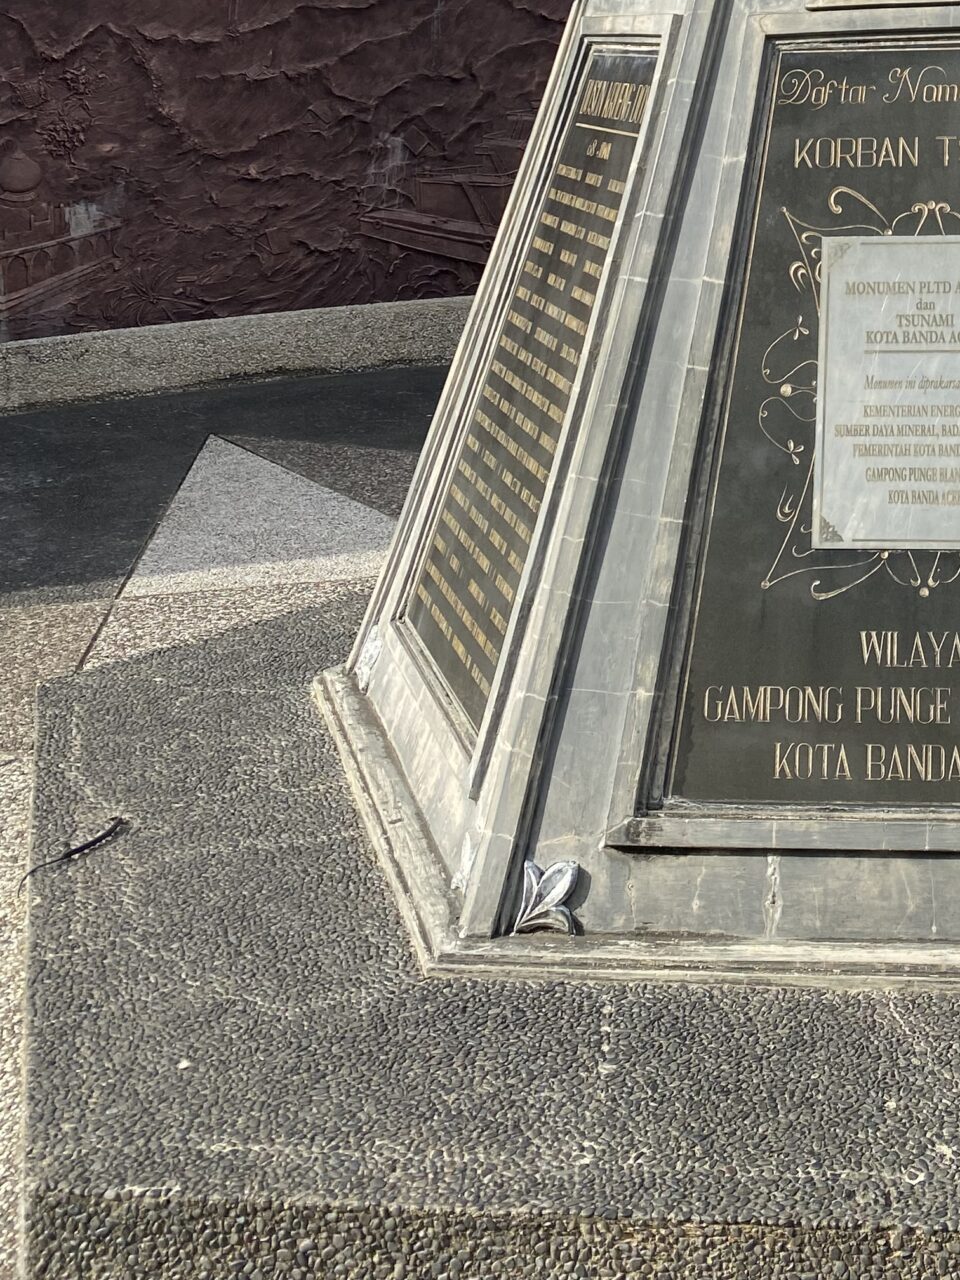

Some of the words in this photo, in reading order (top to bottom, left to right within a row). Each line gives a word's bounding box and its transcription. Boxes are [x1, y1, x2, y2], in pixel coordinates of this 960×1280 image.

[778, 68, 876, 111] Daftar
[793, 136, 920, 169] KORBAN
[845, 281, 916, 295] MONUMEN
[918, 281, 952, 295] PLTD
[916, 298, 936, 311] dan
[896, 313, 955, 328] TSUNAMI
[865, 330, 899, 344] KOTA
[902, 330, 946, 344] BANDA
[863, 375, 903, 390] Monumen
[904, 376, 917, 390] ini
[863, 404, 928, 418] KEMENTERIAN
[834, 424, 870, 438] SUMBER
[872, 424, 895, 437] DAYA
[896, 424, 939, 440] MINERAL,
[853, 443, 912, 457] PEMERINTAH
[913, 443, 937, 457] KOTA
[865, 467, 907, 482] GAMPONG
[908, 467, 938, 482] PUNGE
[888, 489, 909, 504] KOTA
[911, 489, 939, 505] BANDA
[703, 685, 843, 723] GAMPONG
[855, 686, 951, 725] PUNGE
[773, 742, 852, 781] KOTA
